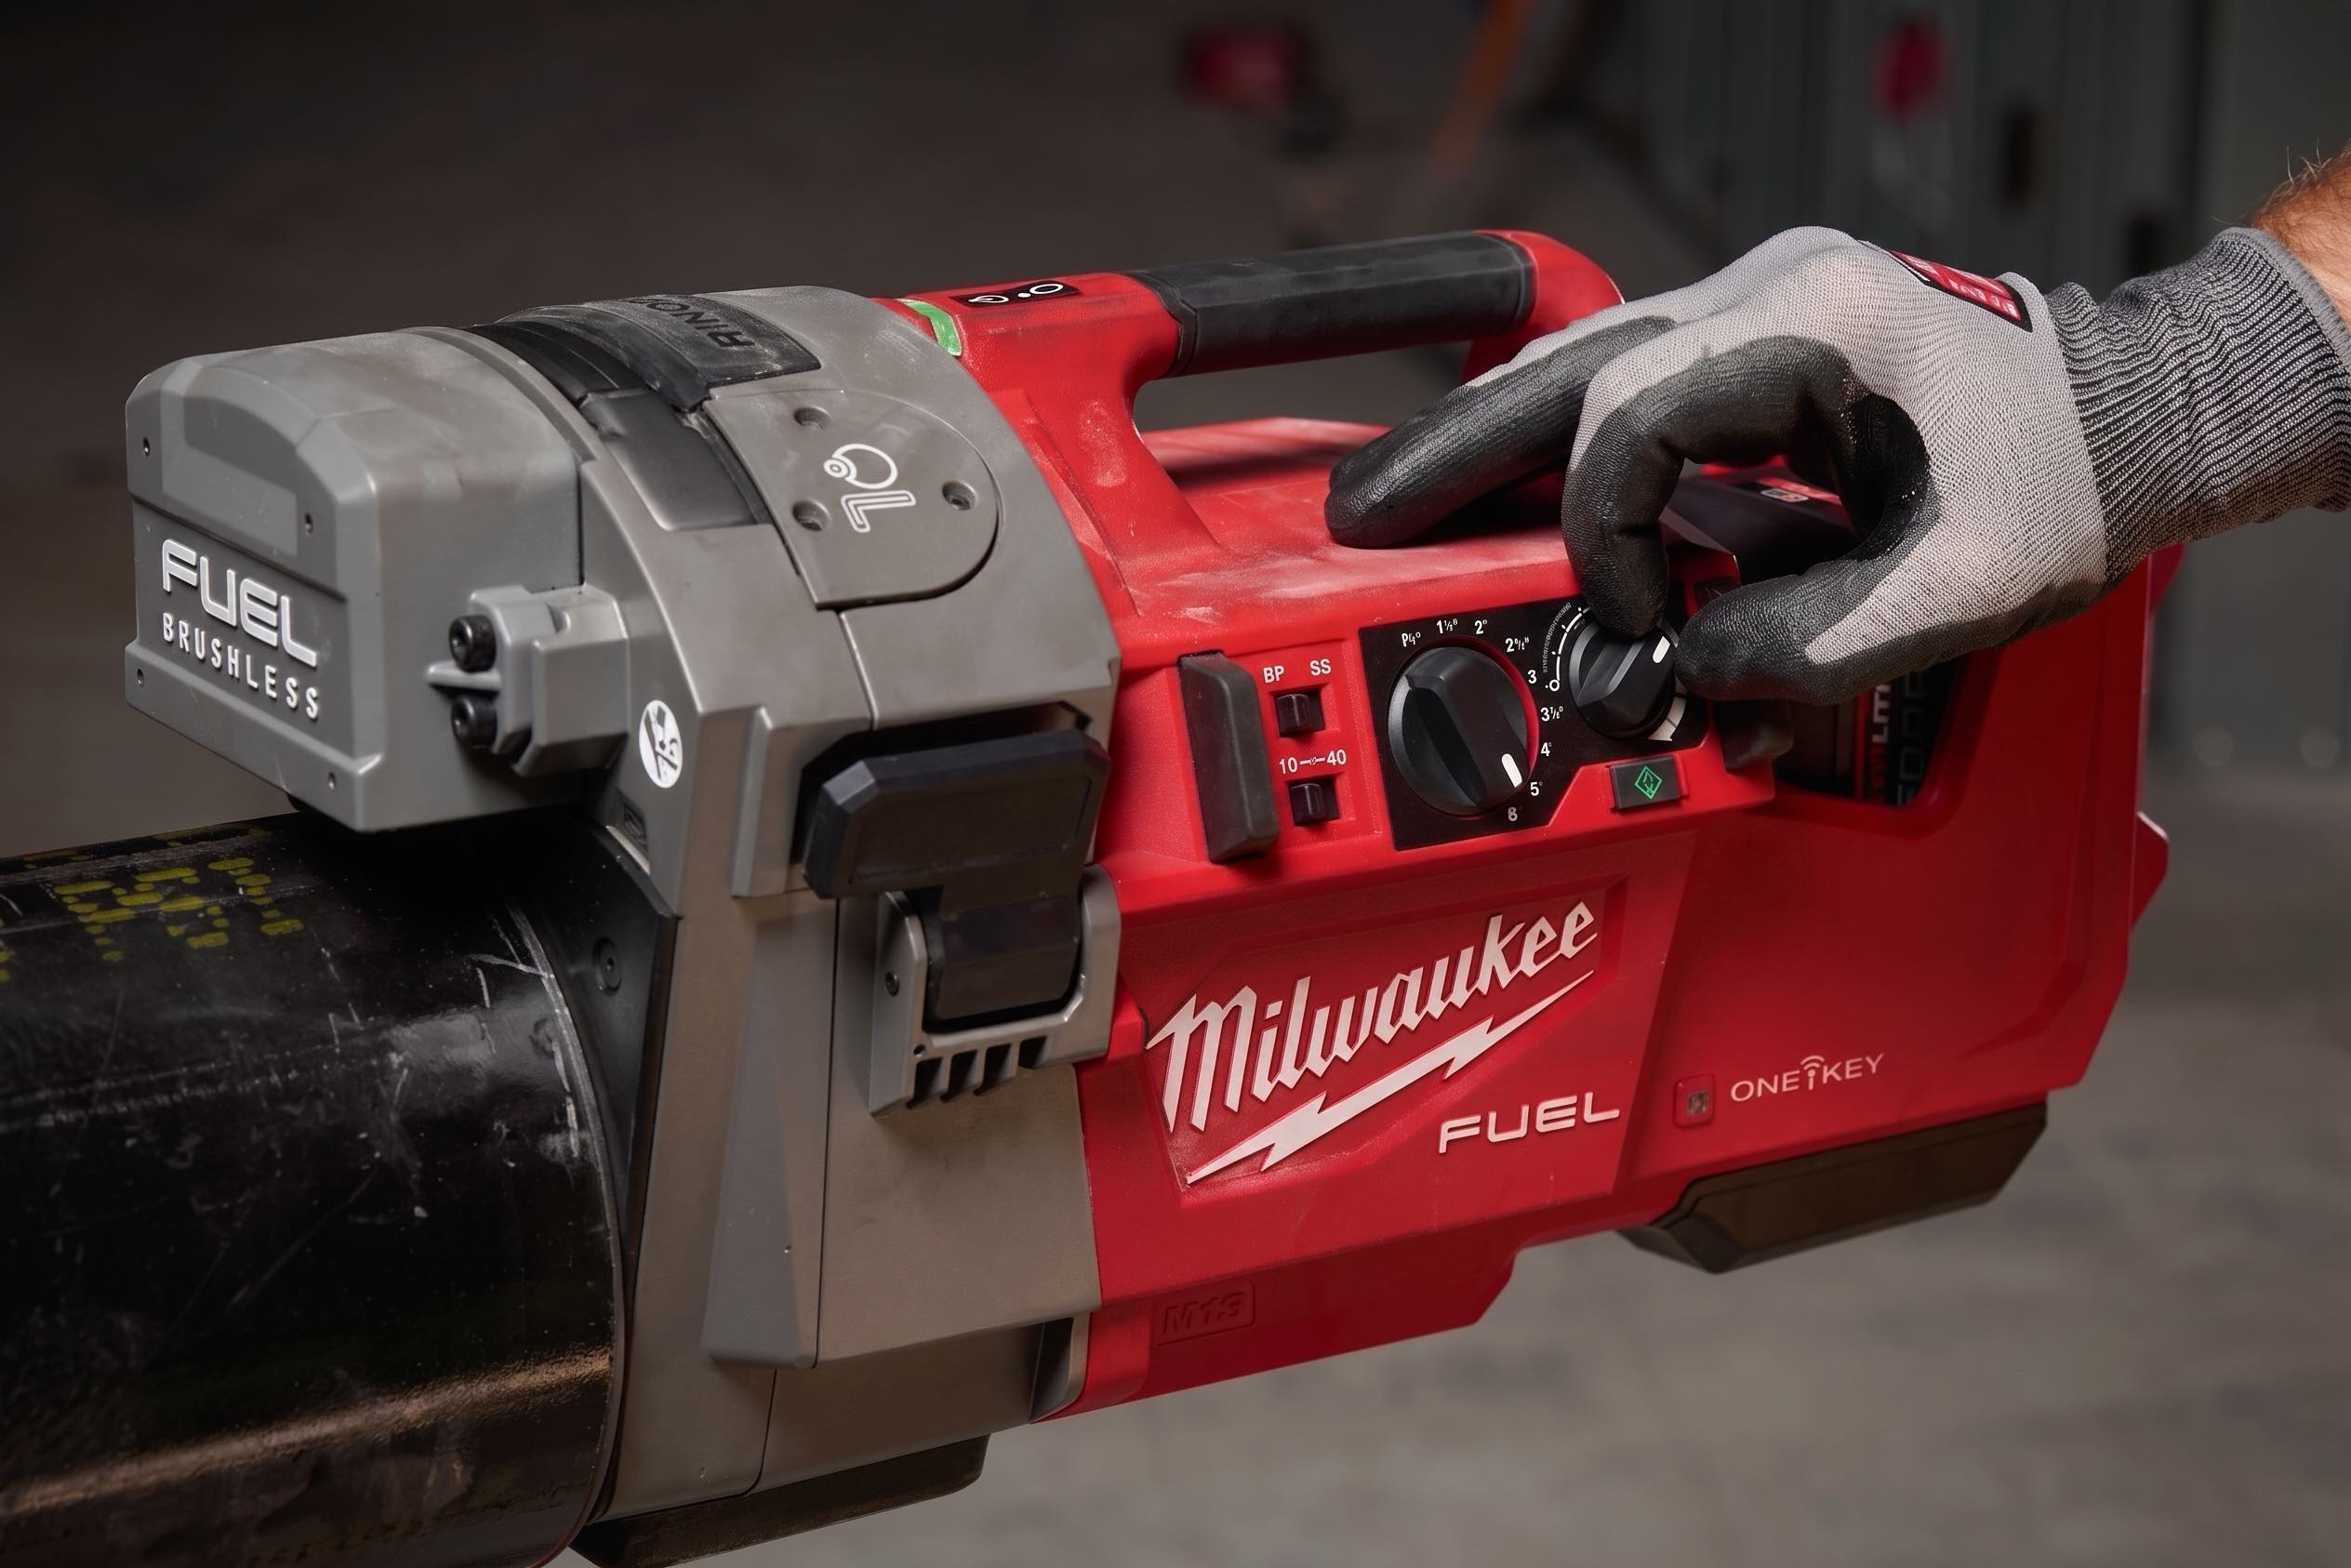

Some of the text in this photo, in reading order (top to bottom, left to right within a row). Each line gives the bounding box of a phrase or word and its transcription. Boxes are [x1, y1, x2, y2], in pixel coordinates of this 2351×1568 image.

[162, 538, 318, 669] FUEL
[162, 611, 320, 720] BRUSHLESS
[1263, 658, 1333, 684] BP SS
[1527, 669, 1538, 684] 3
[1145, 900, 1599, 1135] Milwaukee
[1438, 1091, 1621, 1155] FUEL
